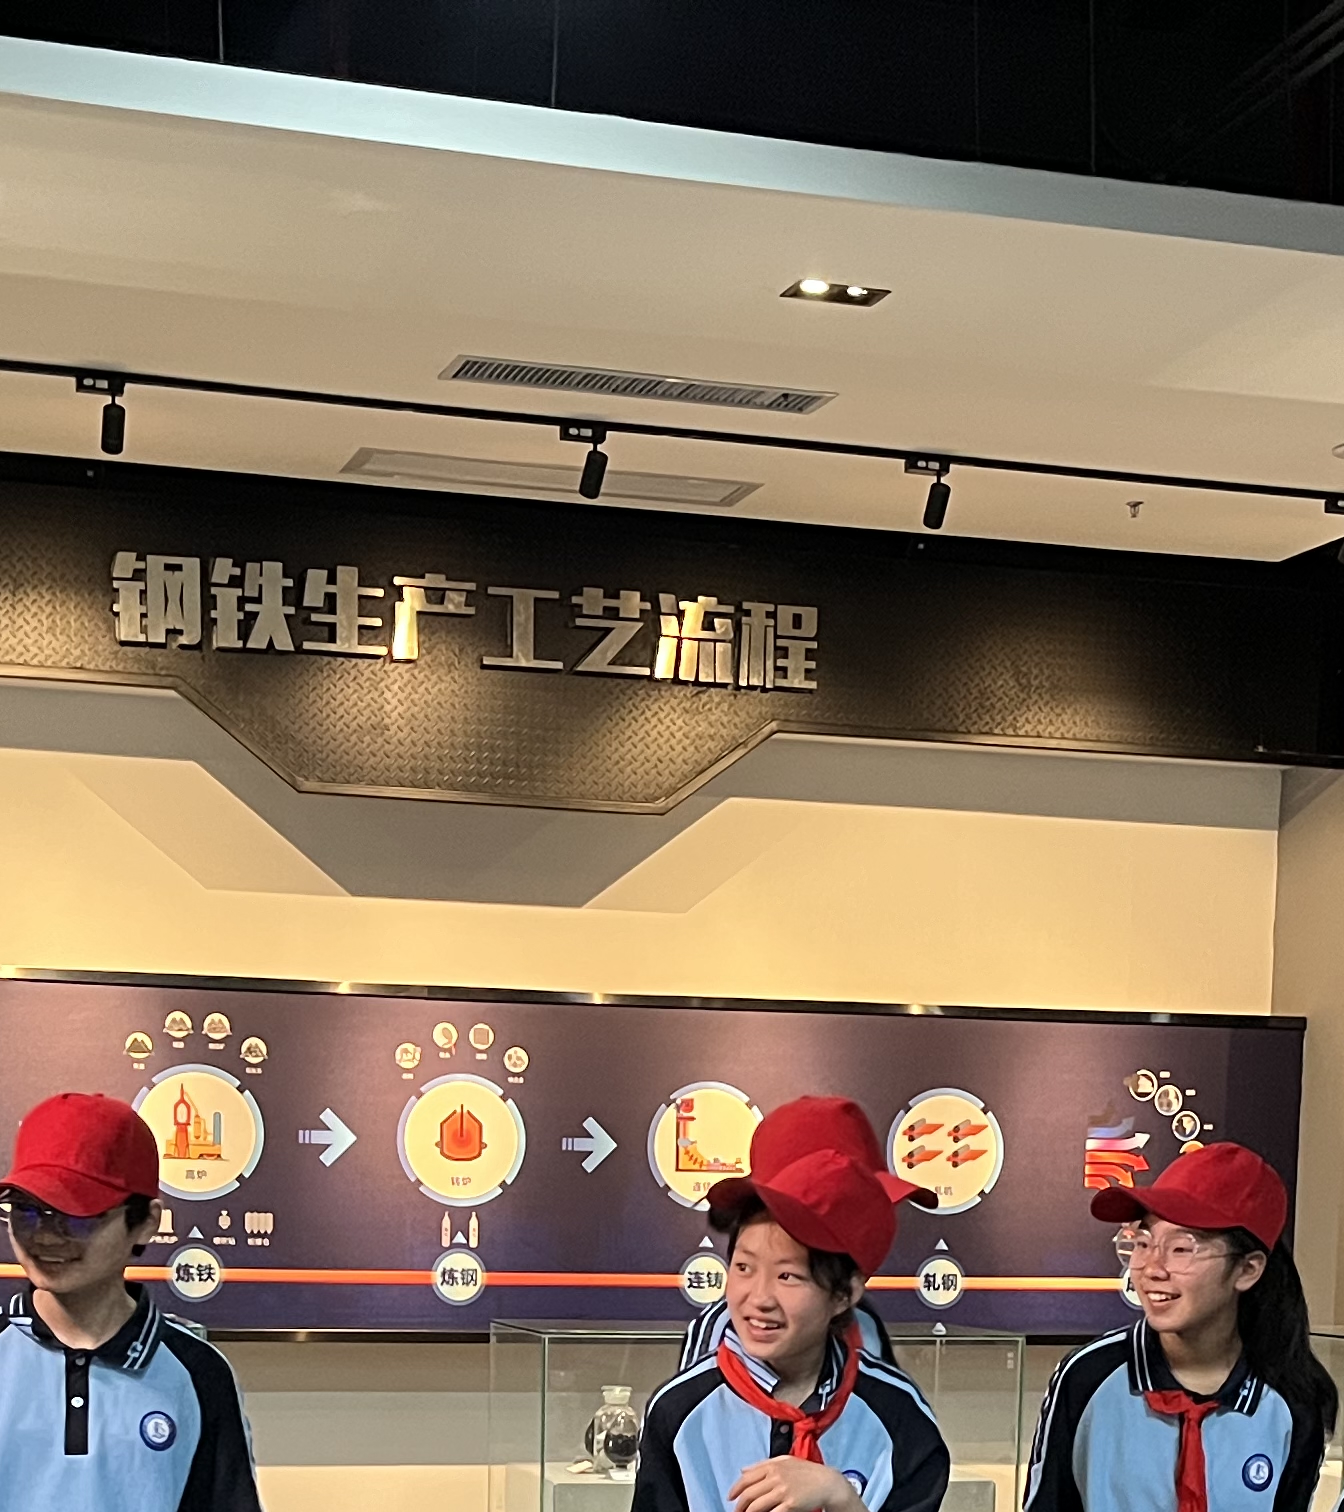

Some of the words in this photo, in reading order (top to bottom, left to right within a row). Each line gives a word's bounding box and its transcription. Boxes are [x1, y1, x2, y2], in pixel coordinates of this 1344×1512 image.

[112, 551, 819, 690] 钢铁生产工艺流程
[175, 1262, 216, 1283] 炼铁
[440, 1267, 478, 1287] 炼钢
[687, 1271, 724, 1289] 连铸
[923, 1272, 958, 1292] 轧钢
